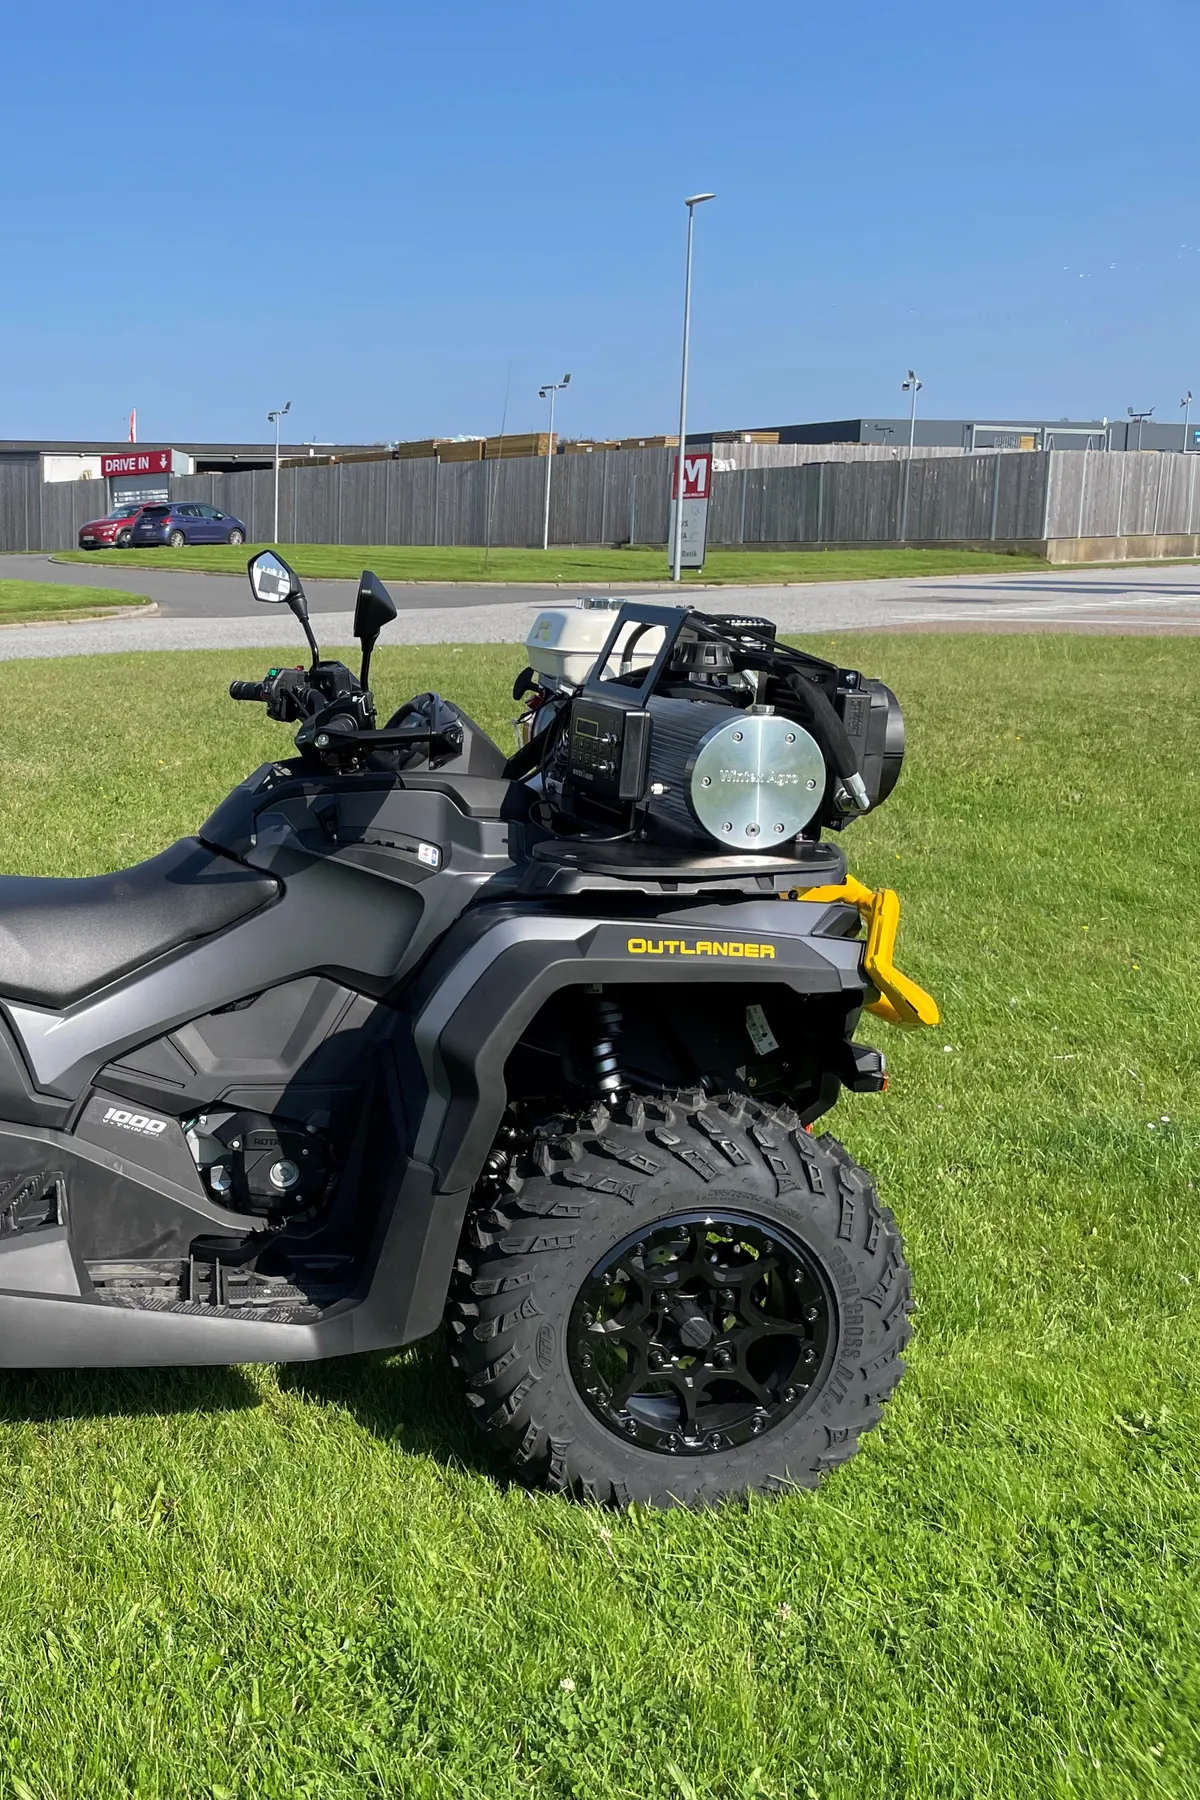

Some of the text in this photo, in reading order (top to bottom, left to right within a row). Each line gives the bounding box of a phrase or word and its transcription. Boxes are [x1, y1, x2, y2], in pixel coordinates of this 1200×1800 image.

[105, 456, 150, 472] DRIVE IN
[719, 769, 800, 787] Wintex Agro
[627, 937, 776, 959] OUTLANDER
[103, 1107, 167, 1133] 1000
[842, 1302, 864, 1360] CROSS
